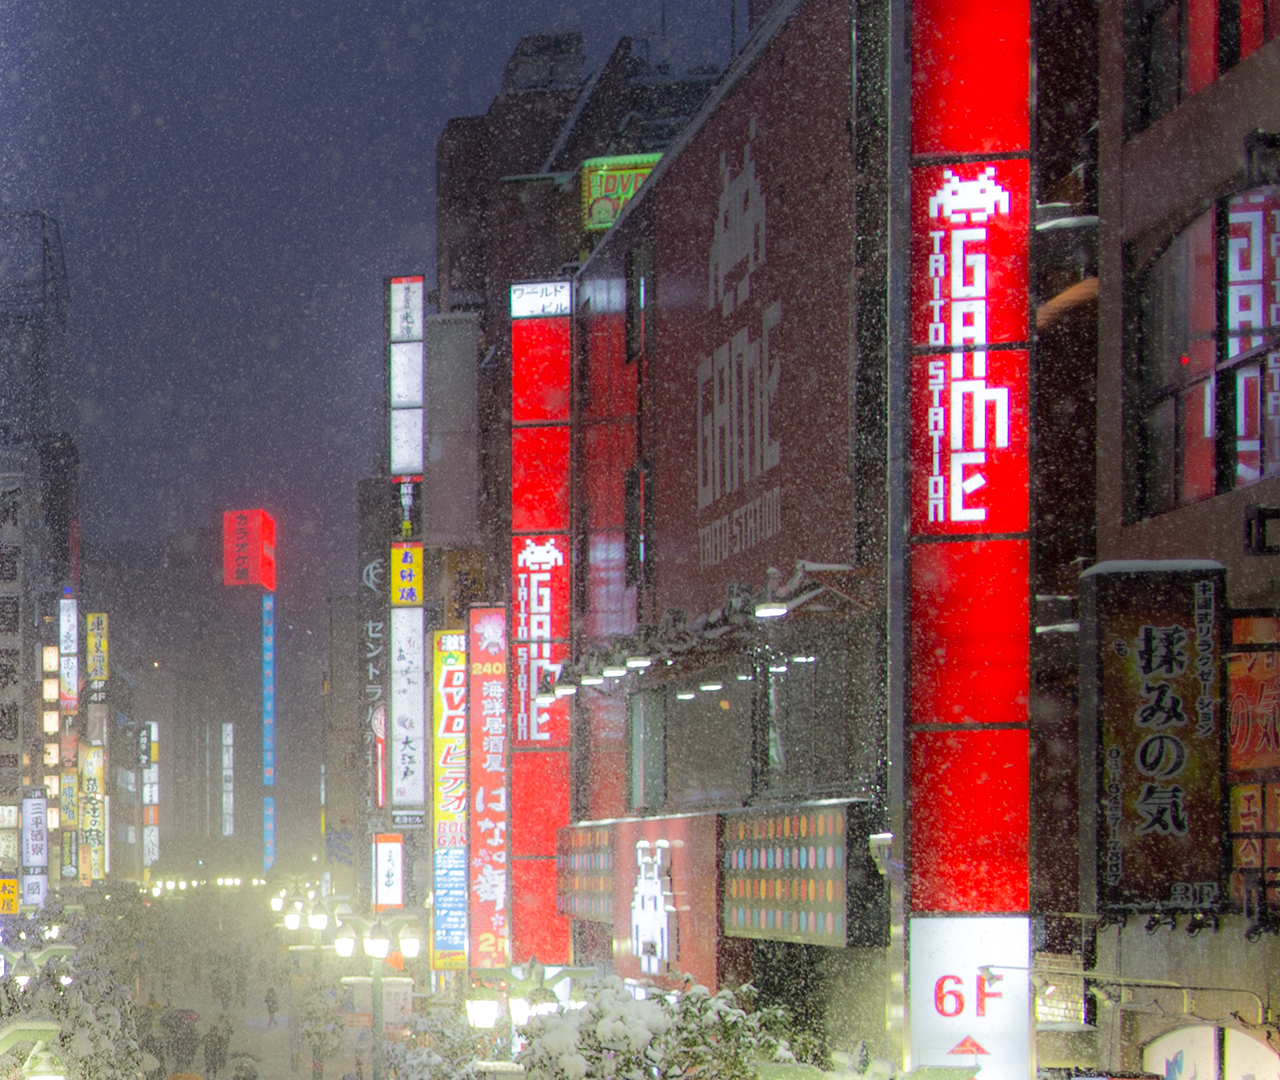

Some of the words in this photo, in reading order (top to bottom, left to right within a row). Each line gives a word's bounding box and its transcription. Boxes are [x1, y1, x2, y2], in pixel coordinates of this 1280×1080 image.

[928, 231, 945, 347] TAITO
[950, 228, 1010, 522] GAME
[928, 361, 945, 522] STATION
[517, 574, 529, 641] TAITO
[482, 680, 506, 773] 海鮮居酒屋
[517, 648, 529, 742] STATION
[1134, 624, 1189, 837] 揉みの気
[0, 882, 15, 911] 松屋
[934, 974, 1004, 1019] 6F
